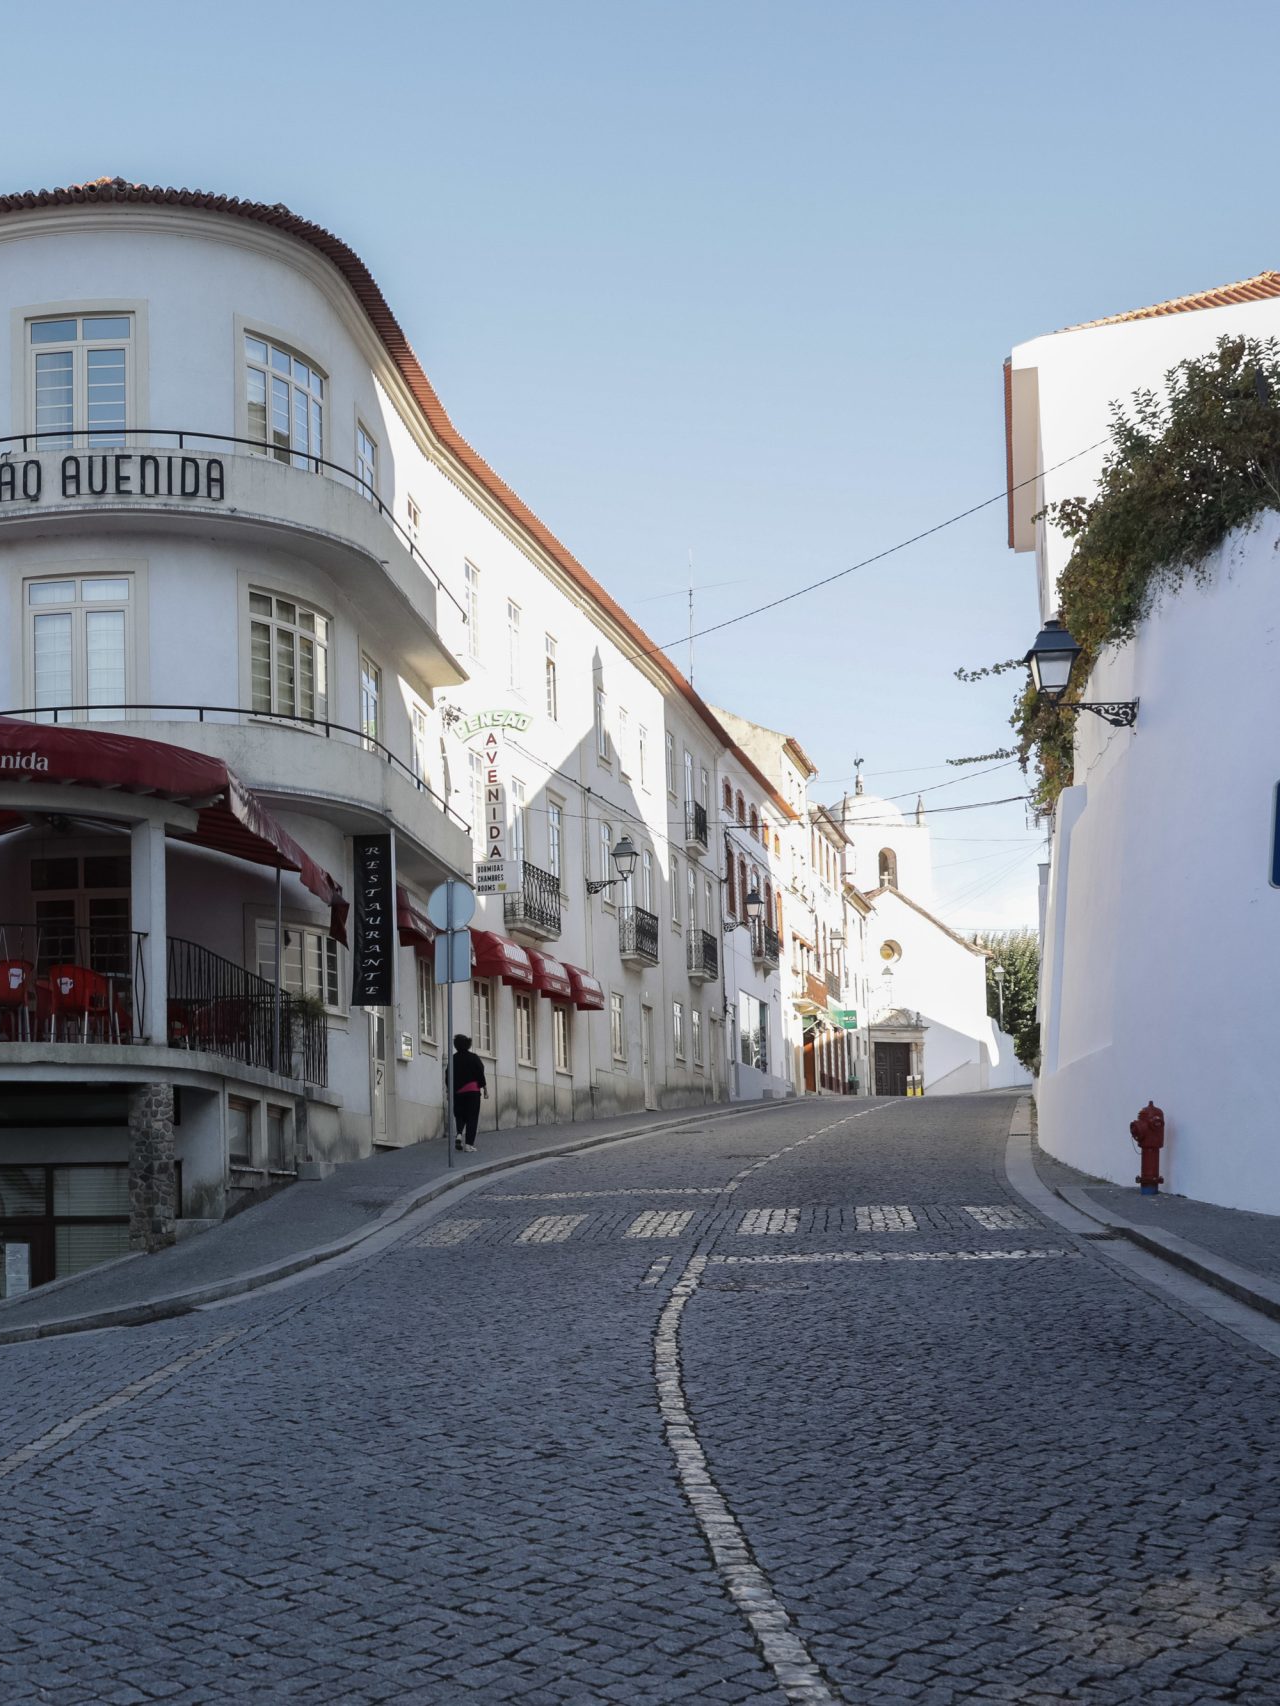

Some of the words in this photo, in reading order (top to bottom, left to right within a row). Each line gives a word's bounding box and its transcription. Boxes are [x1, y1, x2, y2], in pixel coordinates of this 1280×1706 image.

[454, 711, 529, 739] PENSÃO
[485, 732, 502, 858] AVENIDA
[477, 864, 504, 873] DORMIDAS
[478, 874, 504, 882] CHAMBRES
[478, 884, 496, 892] ROOMS
[362, 847, 384, 995] RESTAURANTE
